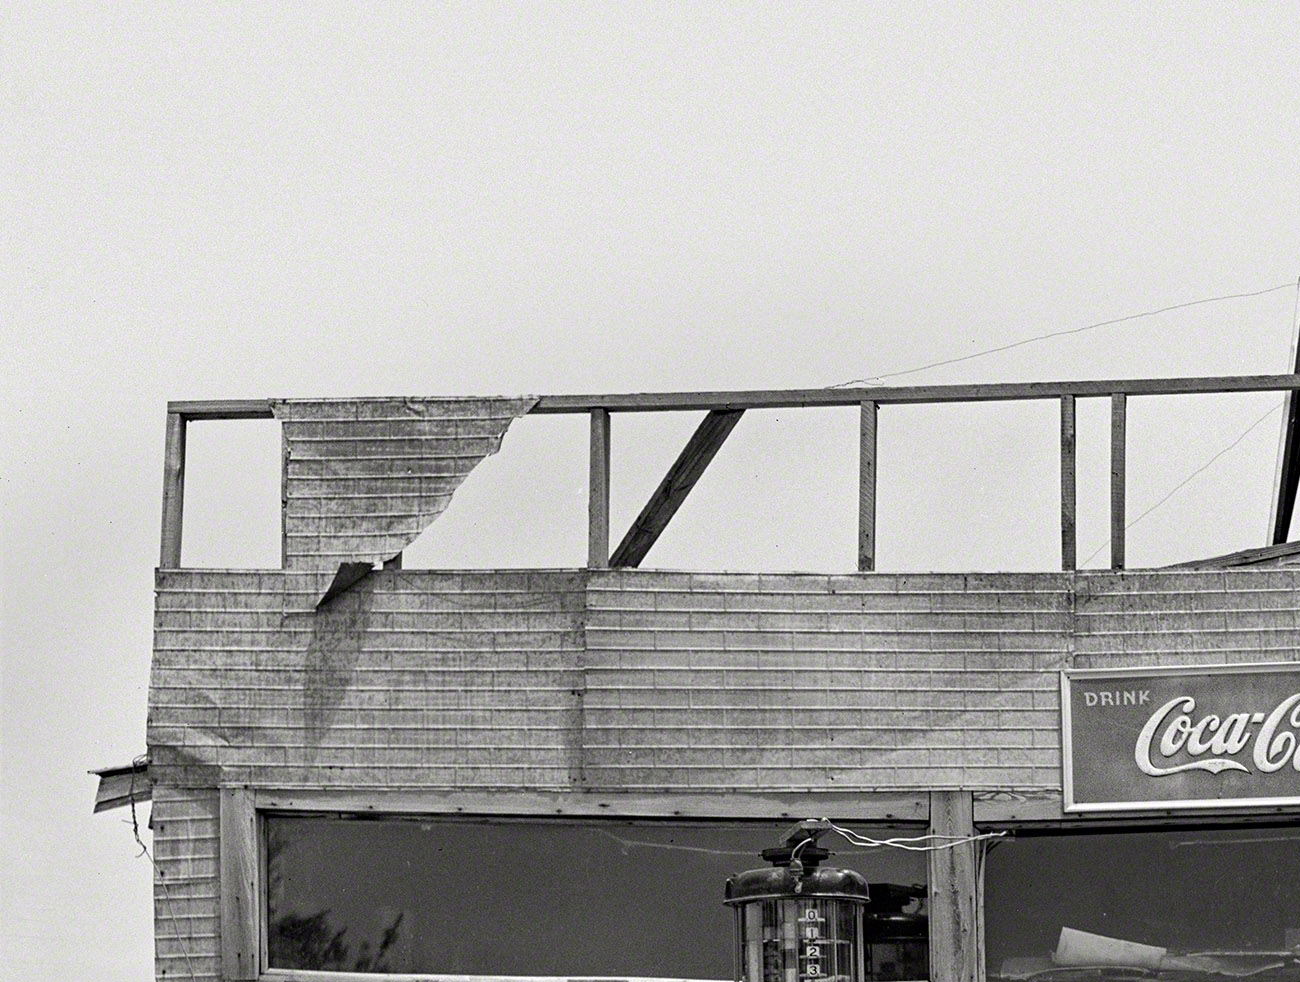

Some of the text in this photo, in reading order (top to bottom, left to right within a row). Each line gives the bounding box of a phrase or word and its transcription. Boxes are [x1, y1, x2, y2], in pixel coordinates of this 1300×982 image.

[1085, 690, 1151, 706] DRINK
[807, 910, 816, 919] 0
[809, 947, 817, 956] 2
[810, 966, 818, 975] 3
